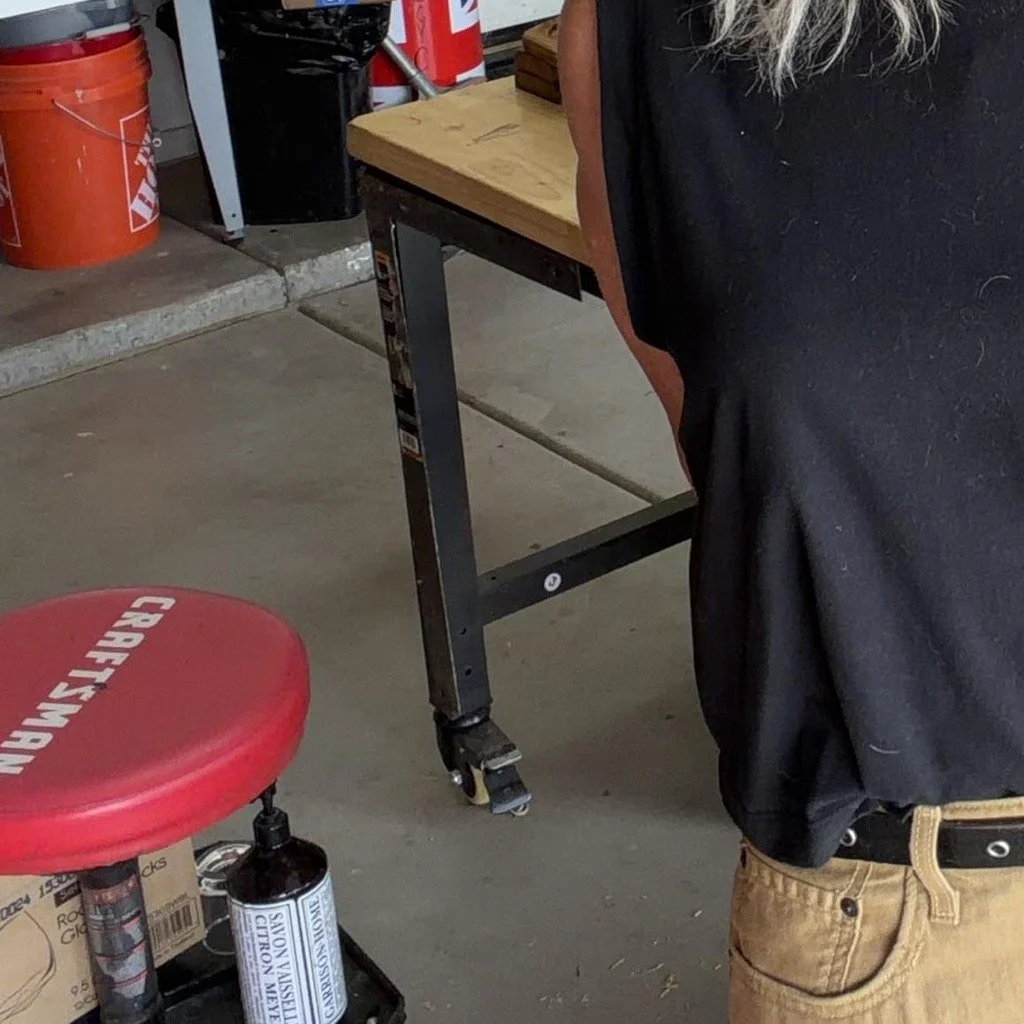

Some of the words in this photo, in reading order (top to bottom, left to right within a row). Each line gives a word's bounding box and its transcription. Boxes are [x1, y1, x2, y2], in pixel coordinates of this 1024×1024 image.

[0, 596, 176, 775] CRAFTSMAN
[255, 914, 274, 976] CITRON
[269, 912, 289, 960] SAVON
[308, 895, 325, 942] HOME
[315, 942, 337, 1020] GARRISON
